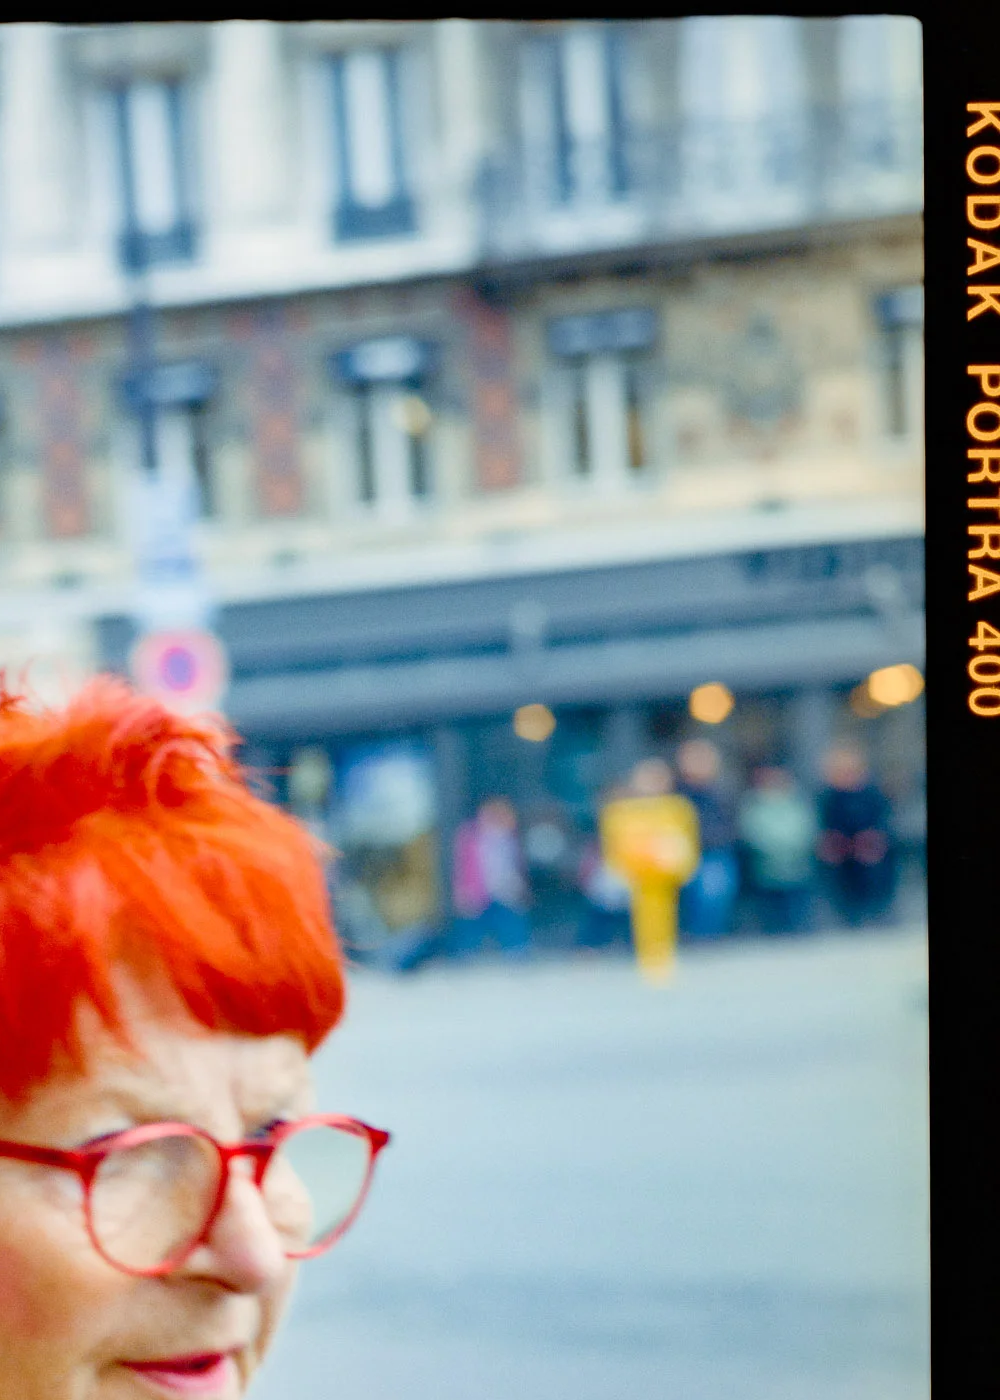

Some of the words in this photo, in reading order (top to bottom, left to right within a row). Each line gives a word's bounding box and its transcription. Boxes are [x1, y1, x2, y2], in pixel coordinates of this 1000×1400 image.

[965, 101, 1000, 322] KODAK
[966, 363, 1000, 602] PORTRA
[967, 620, 1000, 717] 400
